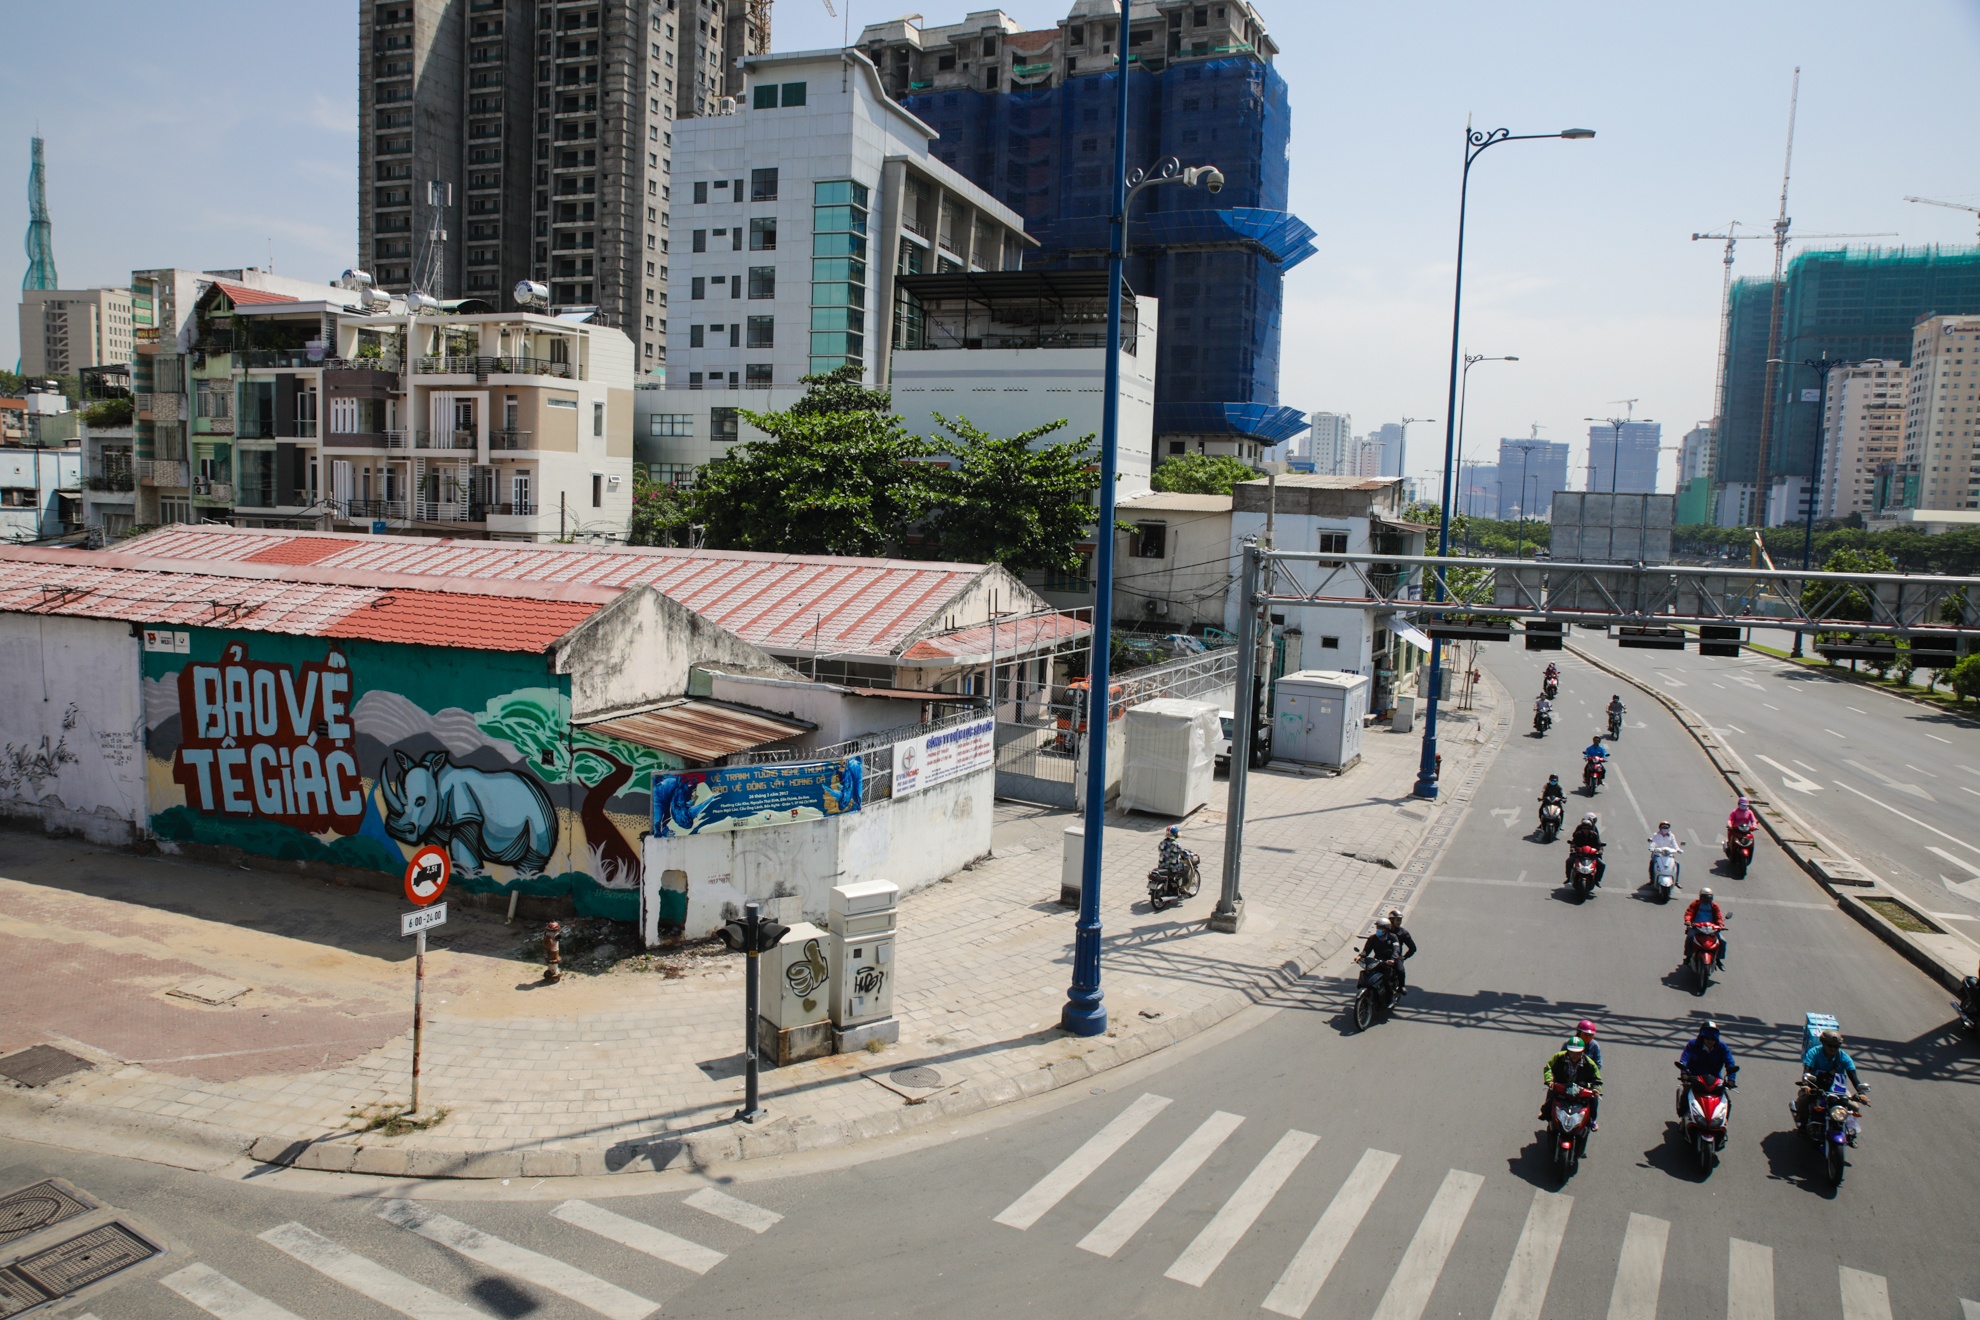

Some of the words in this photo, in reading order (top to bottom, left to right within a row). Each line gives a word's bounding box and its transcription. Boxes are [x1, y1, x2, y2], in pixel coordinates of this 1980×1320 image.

[193, 645, 278, 739] BẢO
[279, 651, 350, 747] VỆ
[182, 736, 253, 813] TÊ
[725, 773, 750, 781] TRANH
